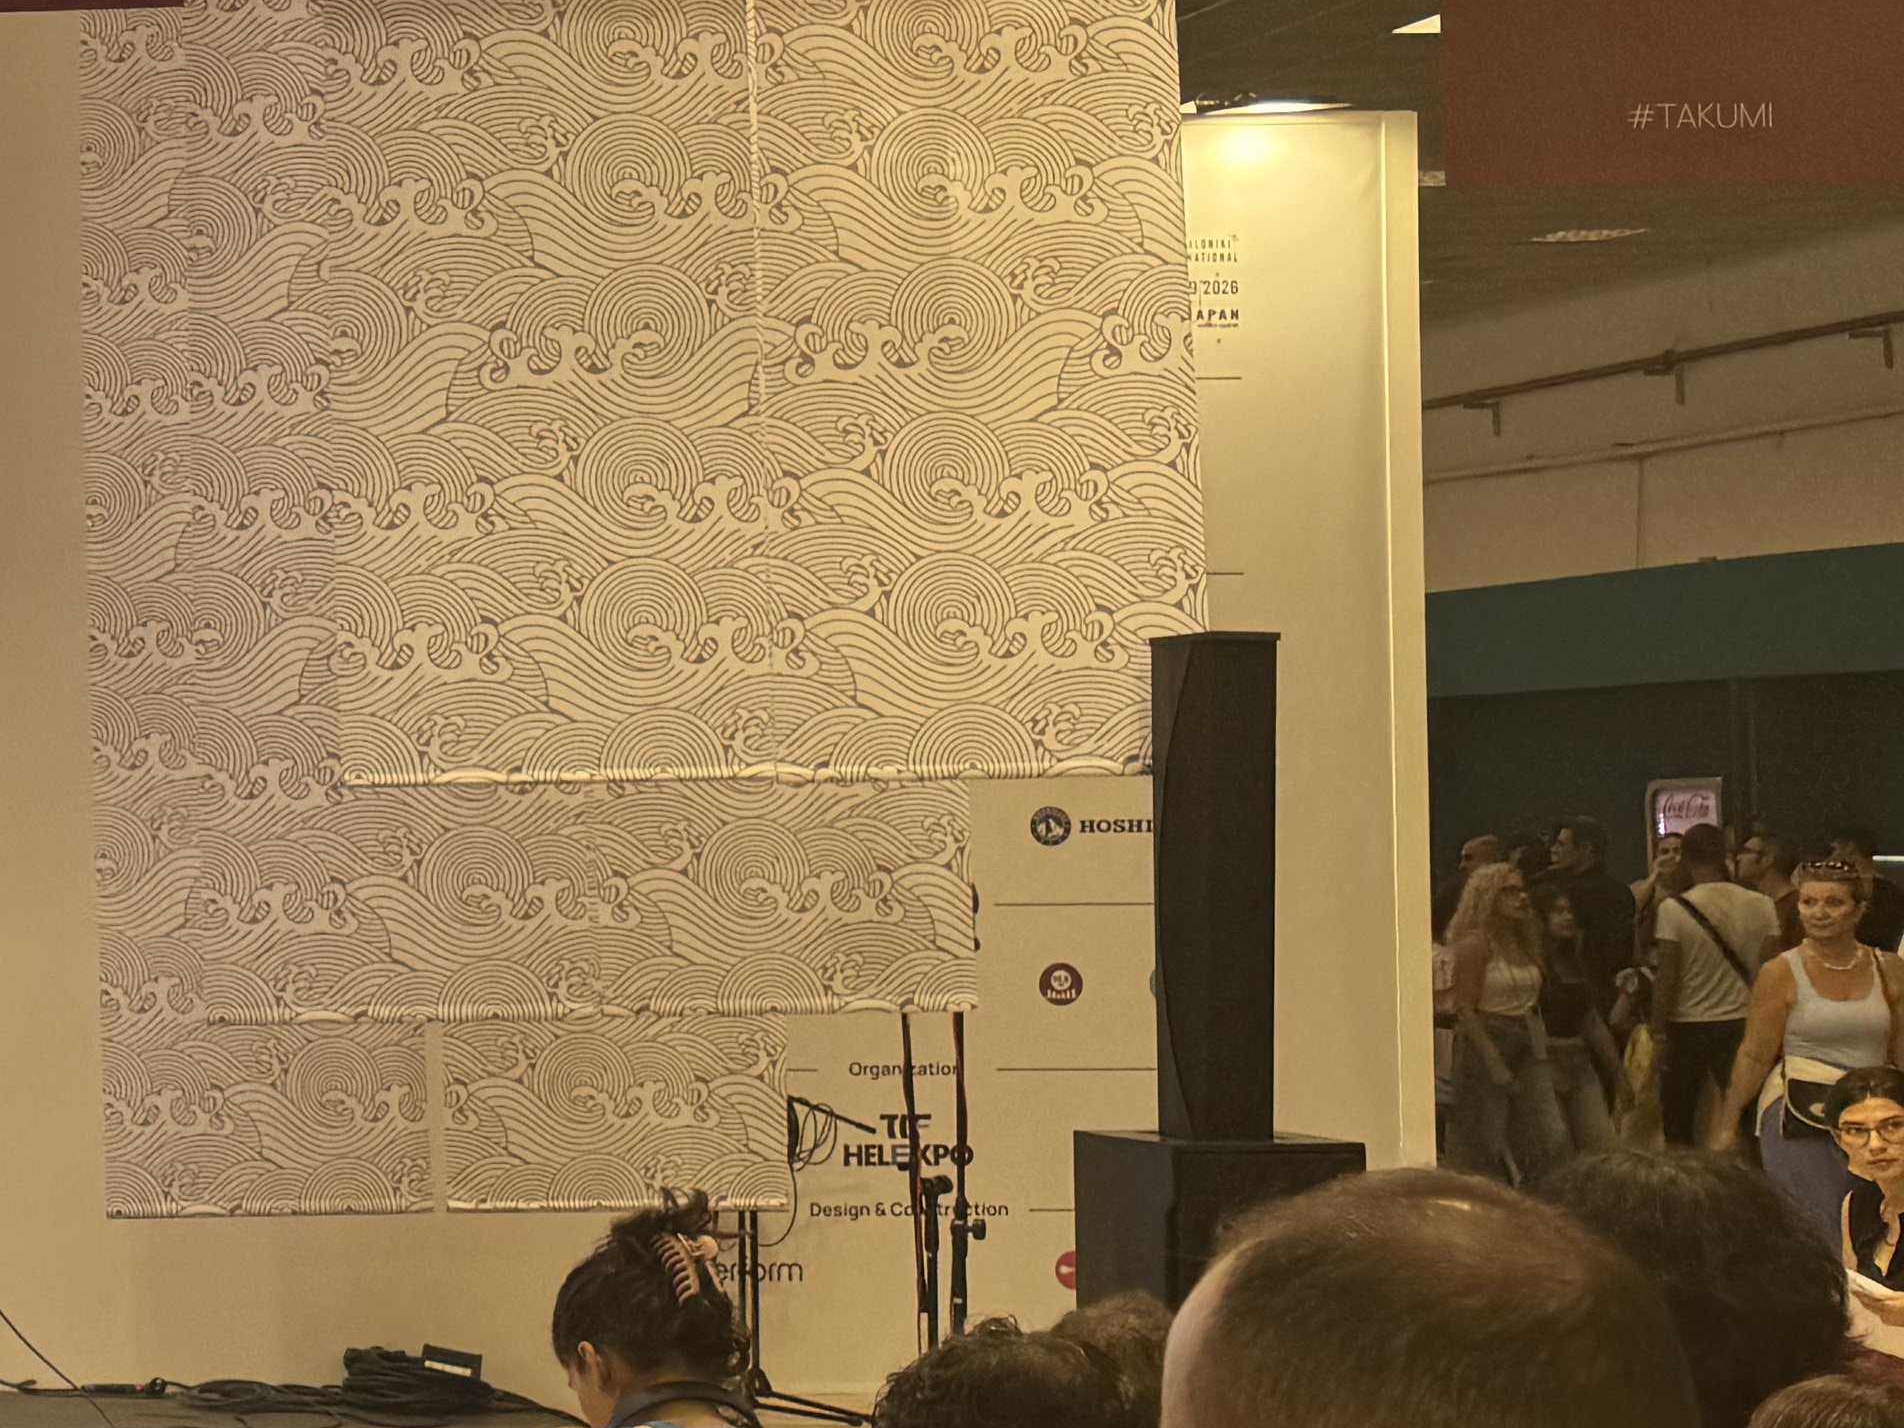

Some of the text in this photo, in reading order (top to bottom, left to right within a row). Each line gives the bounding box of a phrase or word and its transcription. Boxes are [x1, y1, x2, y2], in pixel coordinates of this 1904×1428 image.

[1627, 101, 1773, 129] #TAKUMI
[1202, 280, 1239, 295] 2026
[809, 1202, 871, 1221] Design
[875, 1202, 887, 1217] &
